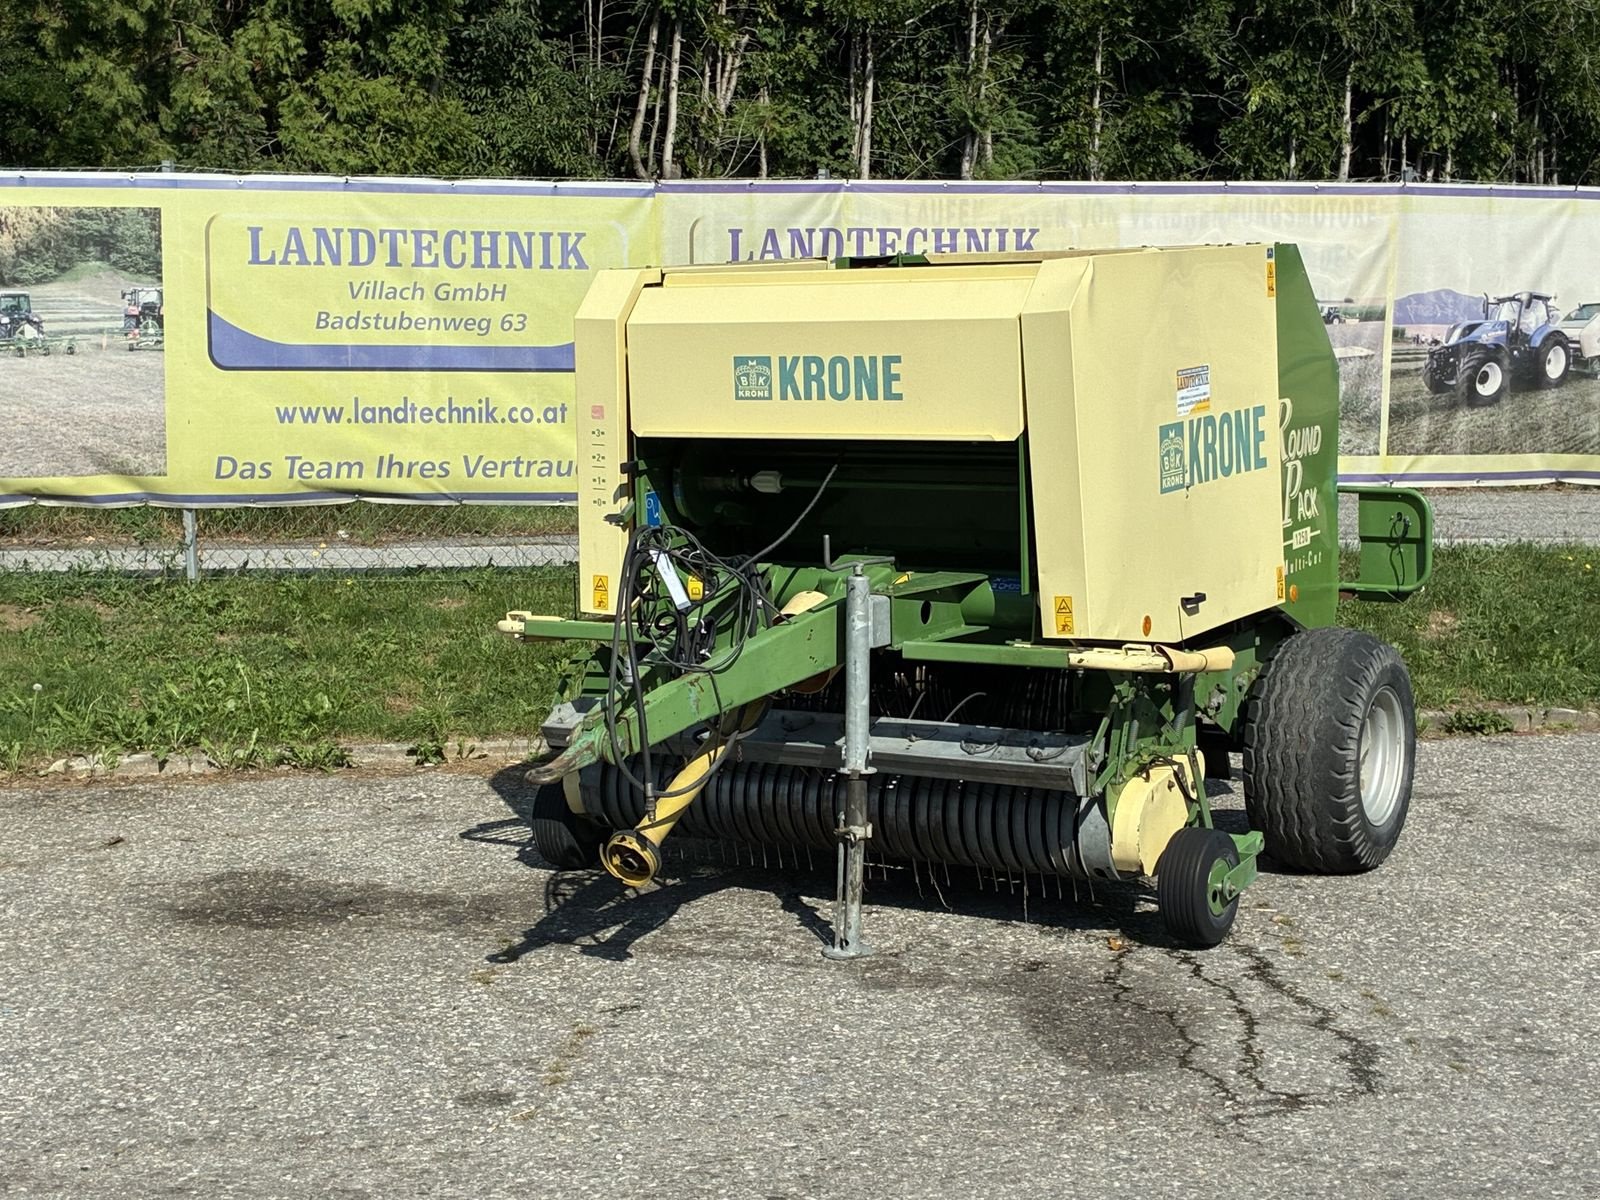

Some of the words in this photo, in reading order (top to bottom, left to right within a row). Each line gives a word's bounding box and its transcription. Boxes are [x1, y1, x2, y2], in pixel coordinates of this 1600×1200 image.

[247, 226, 589, 270] LANDTECHNIK
[727, 227, 1040, 263] LANDTECHNIK
[348, 280, 425, 301] Villach
[434, 282, 507, 303] GmbH
[315, 311, 492, 337] Badstubenweg
[500, 313, 528, 332] 63
[778, 355, 904, 402] KRONE
[738, 390, 769, 398] KRONE
[275, 396, 568, 424] www.landtechnik.co.at
[1189, 405, 1267, 486] KRONE
[214, 455, 273, 480] Das
[284, 455, 365, 480] Team
[376, 453, 451, 479] Ihres
[462, 454, 578, 479] Vertrau
[1162, 474, 1184, 489] KRONE
